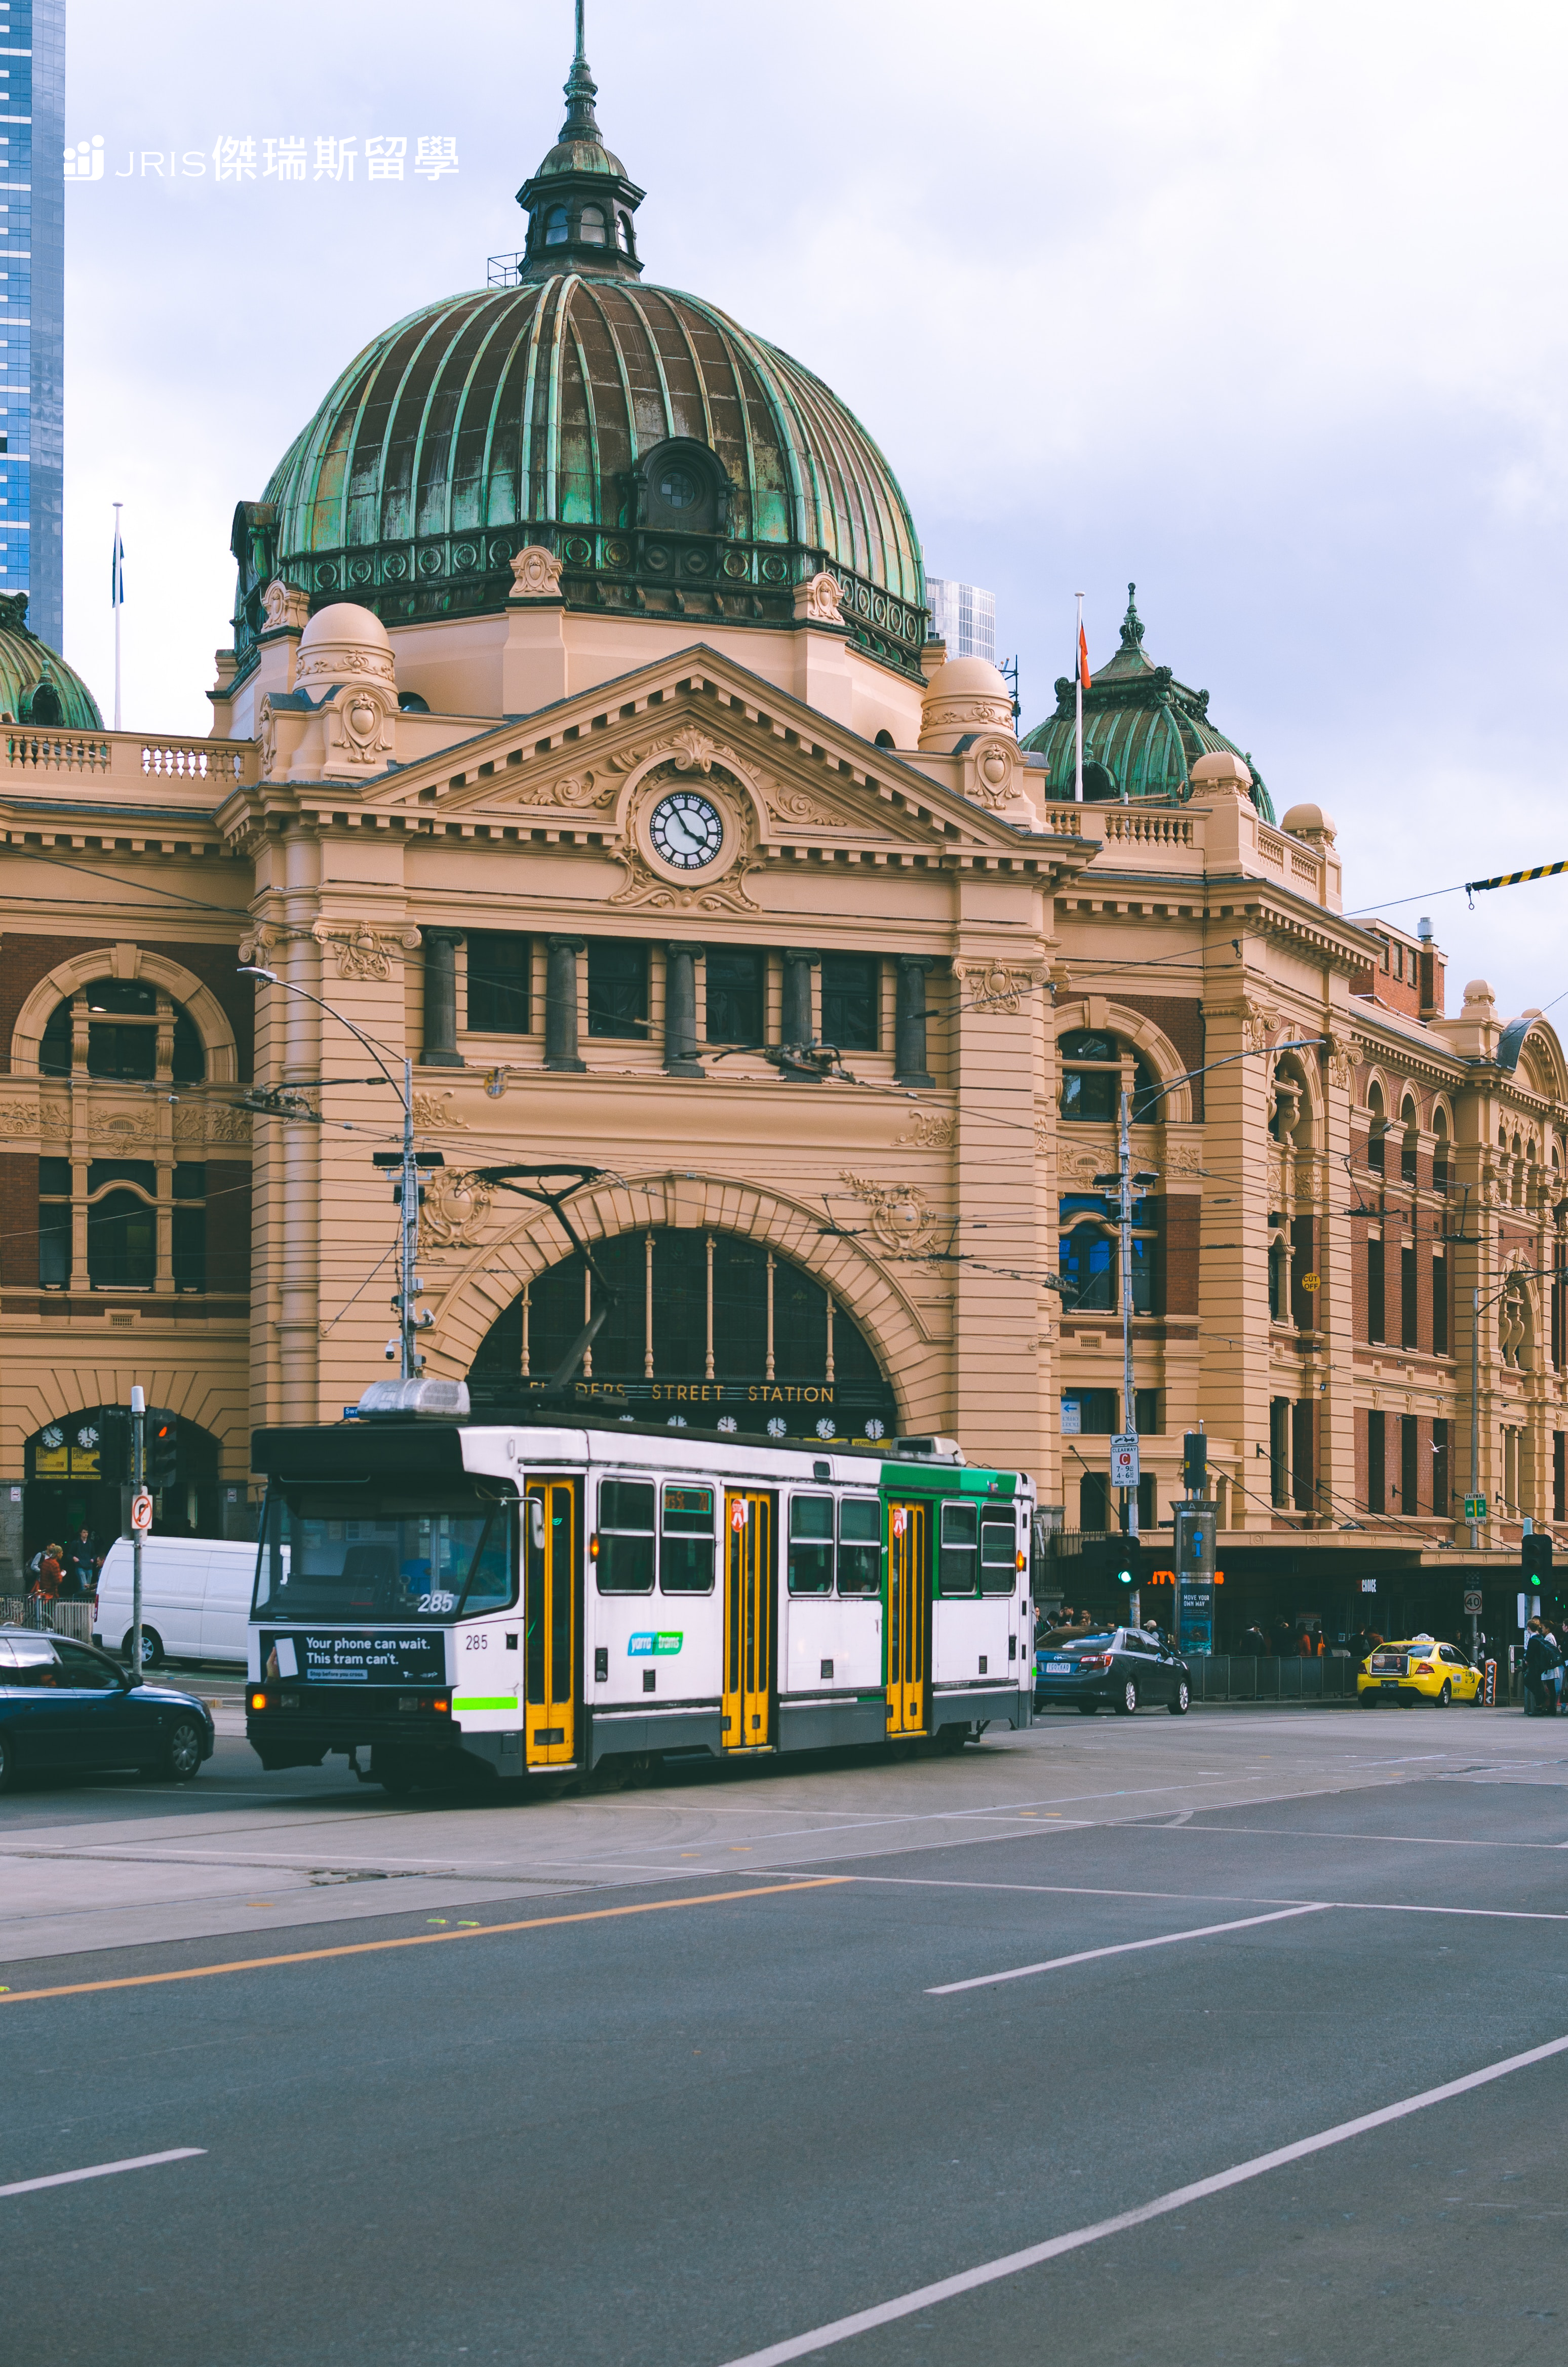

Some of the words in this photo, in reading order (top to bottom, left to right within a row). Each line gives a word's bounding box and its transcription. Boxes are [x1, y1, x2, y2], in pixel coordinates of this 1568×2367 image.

[652, 1384, 724, 1400] STREET
[748, 1386, 833, 1402] STATION
[1147, 1570, 1175, 1585] ITY
[1361, 1579, 1377, 1593] CHOICE
[417, 1593, 455, 1612] 285
[1466, 1597, 1479, 1607] 40
[306, 1637, 332, 1648] Your
[335, 1637, 372, 1651] phone
[374, 1640, 396, 1649] can
[399, 1637, 430, 1649] wait.
[466, 1635, 488, 1650] 285
[631, 1637, 652, 1653] yarra
[658, 1634, 679, 1648] trams
[306, 1652, 331, 1664] This
[333, 1653, 363, 1665] tram
[366, 1652, 399, 1665] can't.
